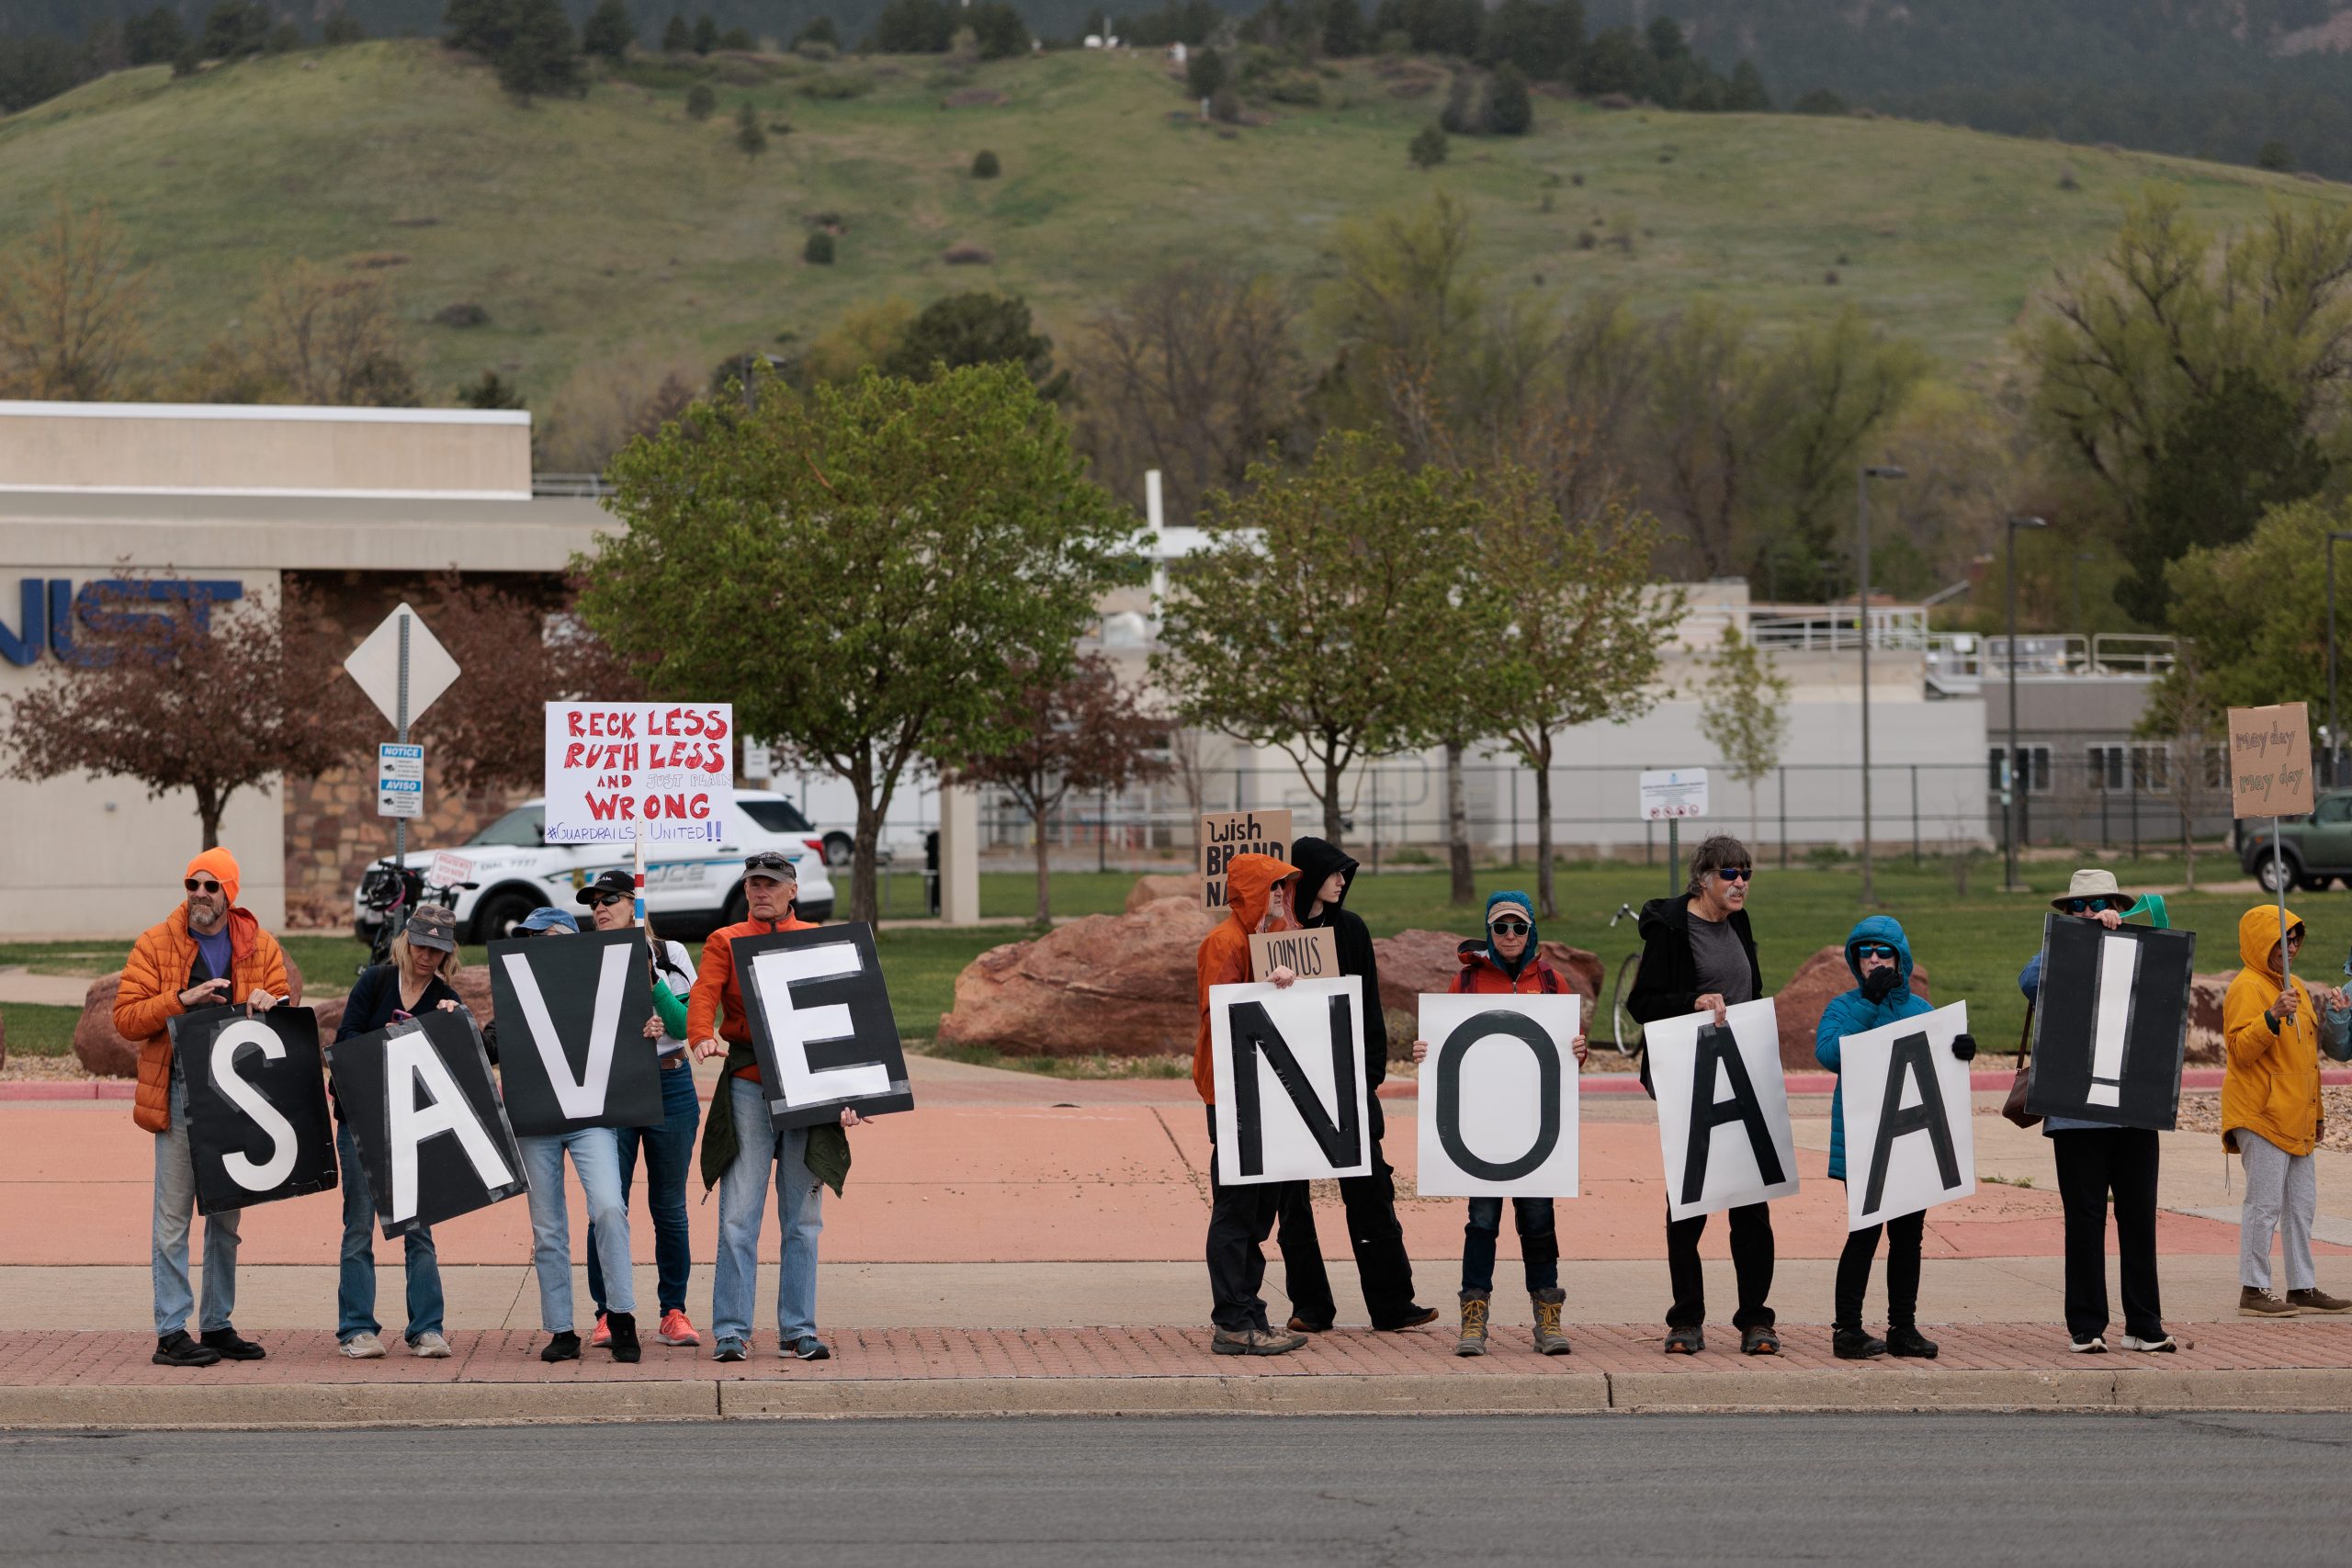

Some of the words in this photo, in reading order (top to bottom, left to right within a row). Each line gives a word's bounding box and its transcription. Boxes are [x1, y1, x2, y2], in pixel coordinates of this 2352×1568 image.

[384, 747, 419, 758] NOTICE
[386, 781, 417, 791] AVISO
[584, 791, 710, 820] WRONG
[597, 774, 632, 789] AND
[646, 773, 684, 790] JUST
[690, 773, 733, 787] PLAIN
[211, 1020, 298, 1191] S
[501, 942, 633, 1120] V
[752, 942, 892, 1108] E
[1228, 993, 1363, 1177] N
[1436, 1009, 1561, 1182] O
[2086, 935, 2138, 1108] !
[386, 1030, 514, 1224] A
[1680, 1021, 1787, 1205] A
[1861, 1031, 1962, 1216] A
